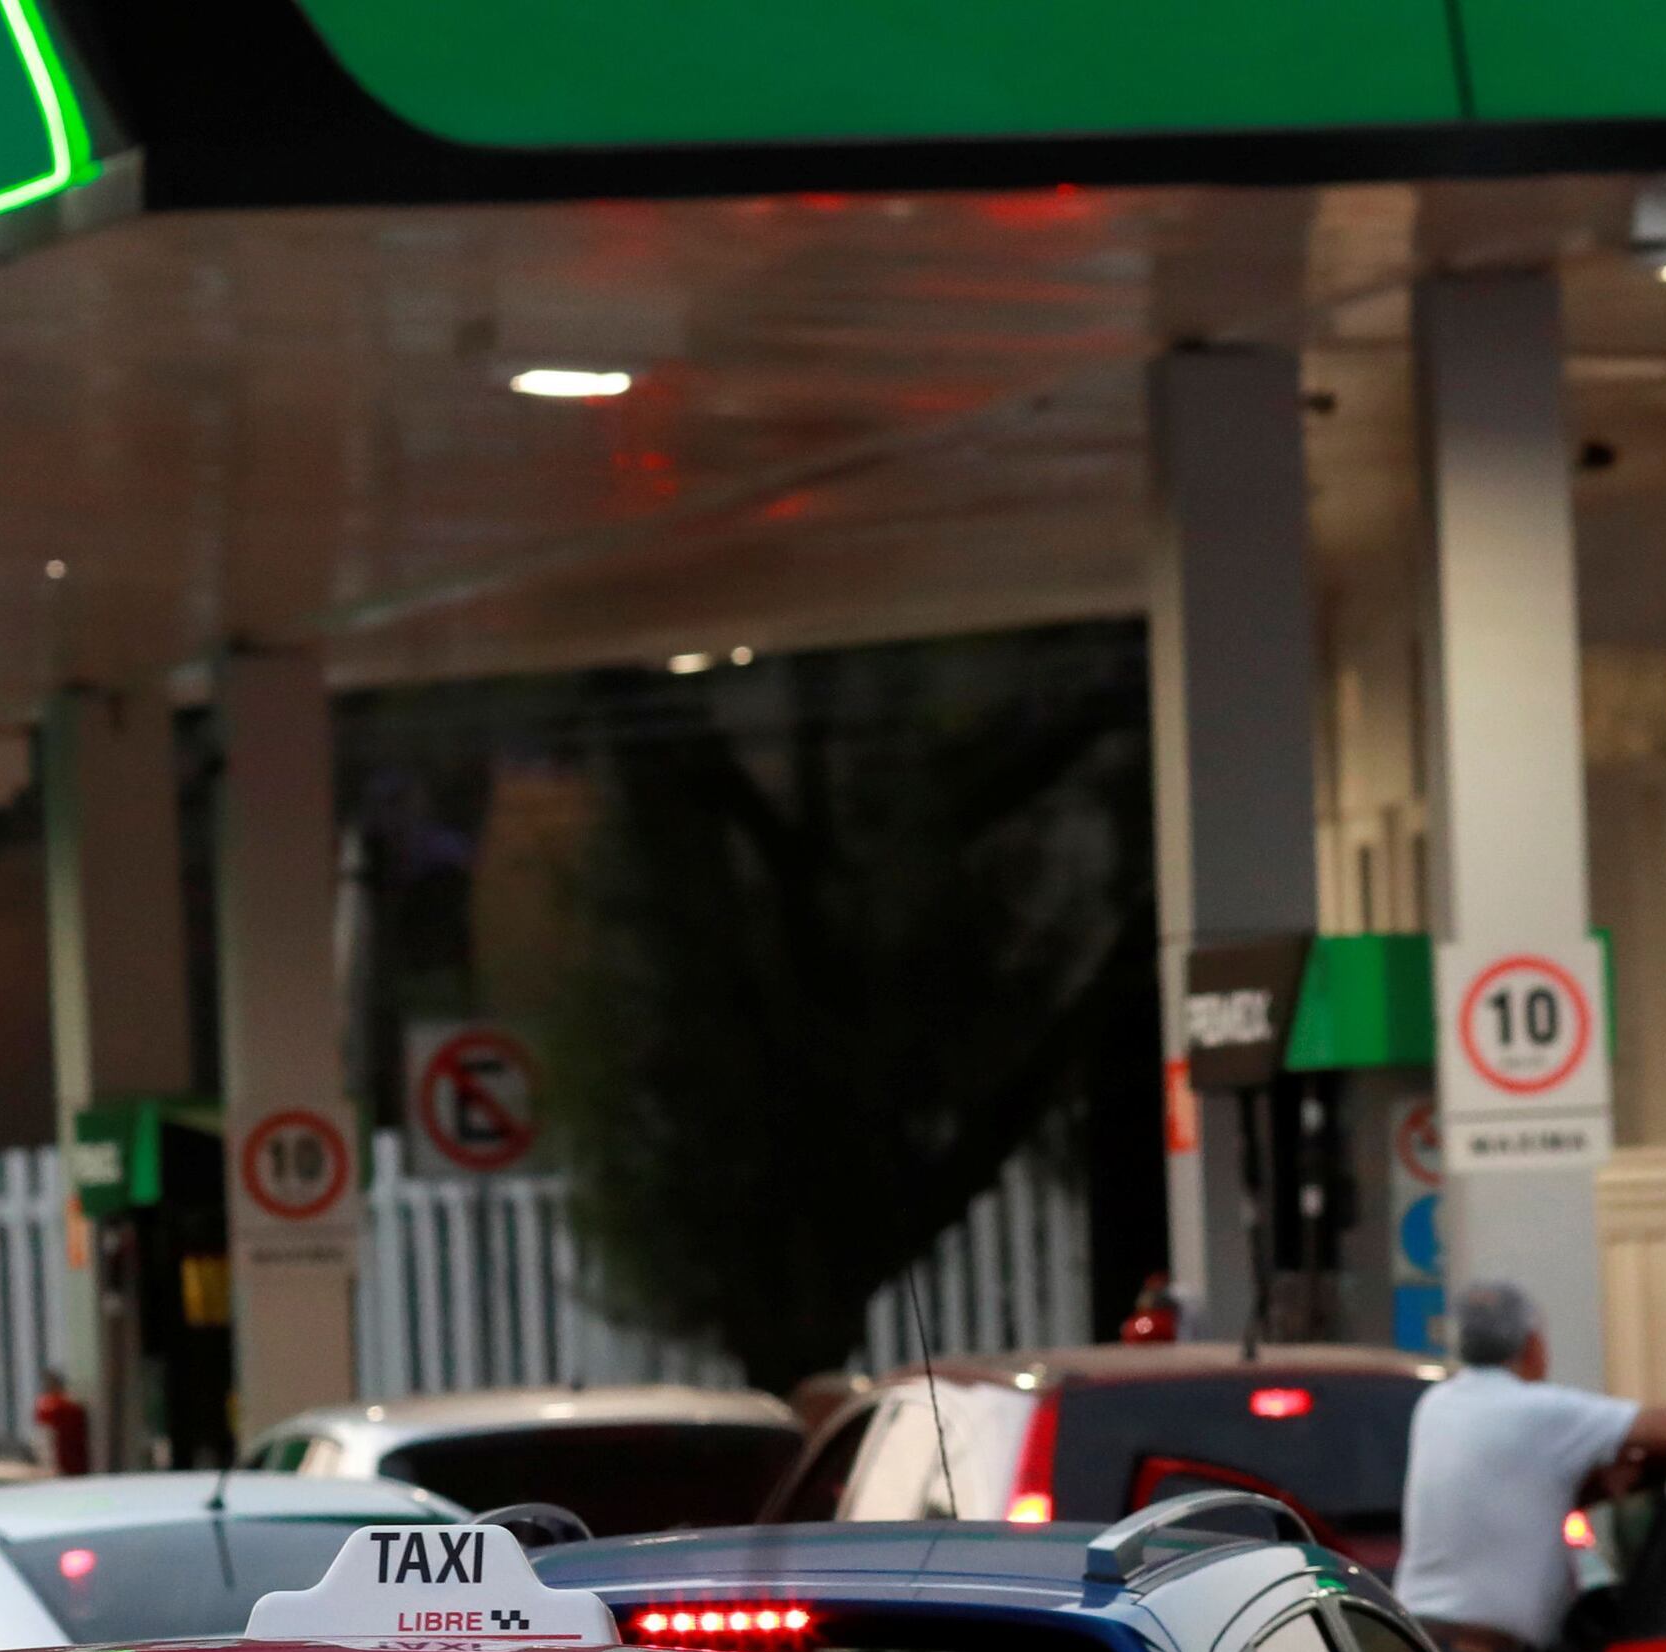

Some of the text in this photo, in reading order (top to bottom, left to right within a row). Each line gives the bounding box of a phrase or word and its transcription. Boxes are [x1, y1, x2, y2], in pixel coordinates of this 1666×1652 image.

[1488, 984, 1558, 1046] 10
[369, 1532, 484, 1583] TAXI
[397, 1612, 483, 1632] LIBRE
